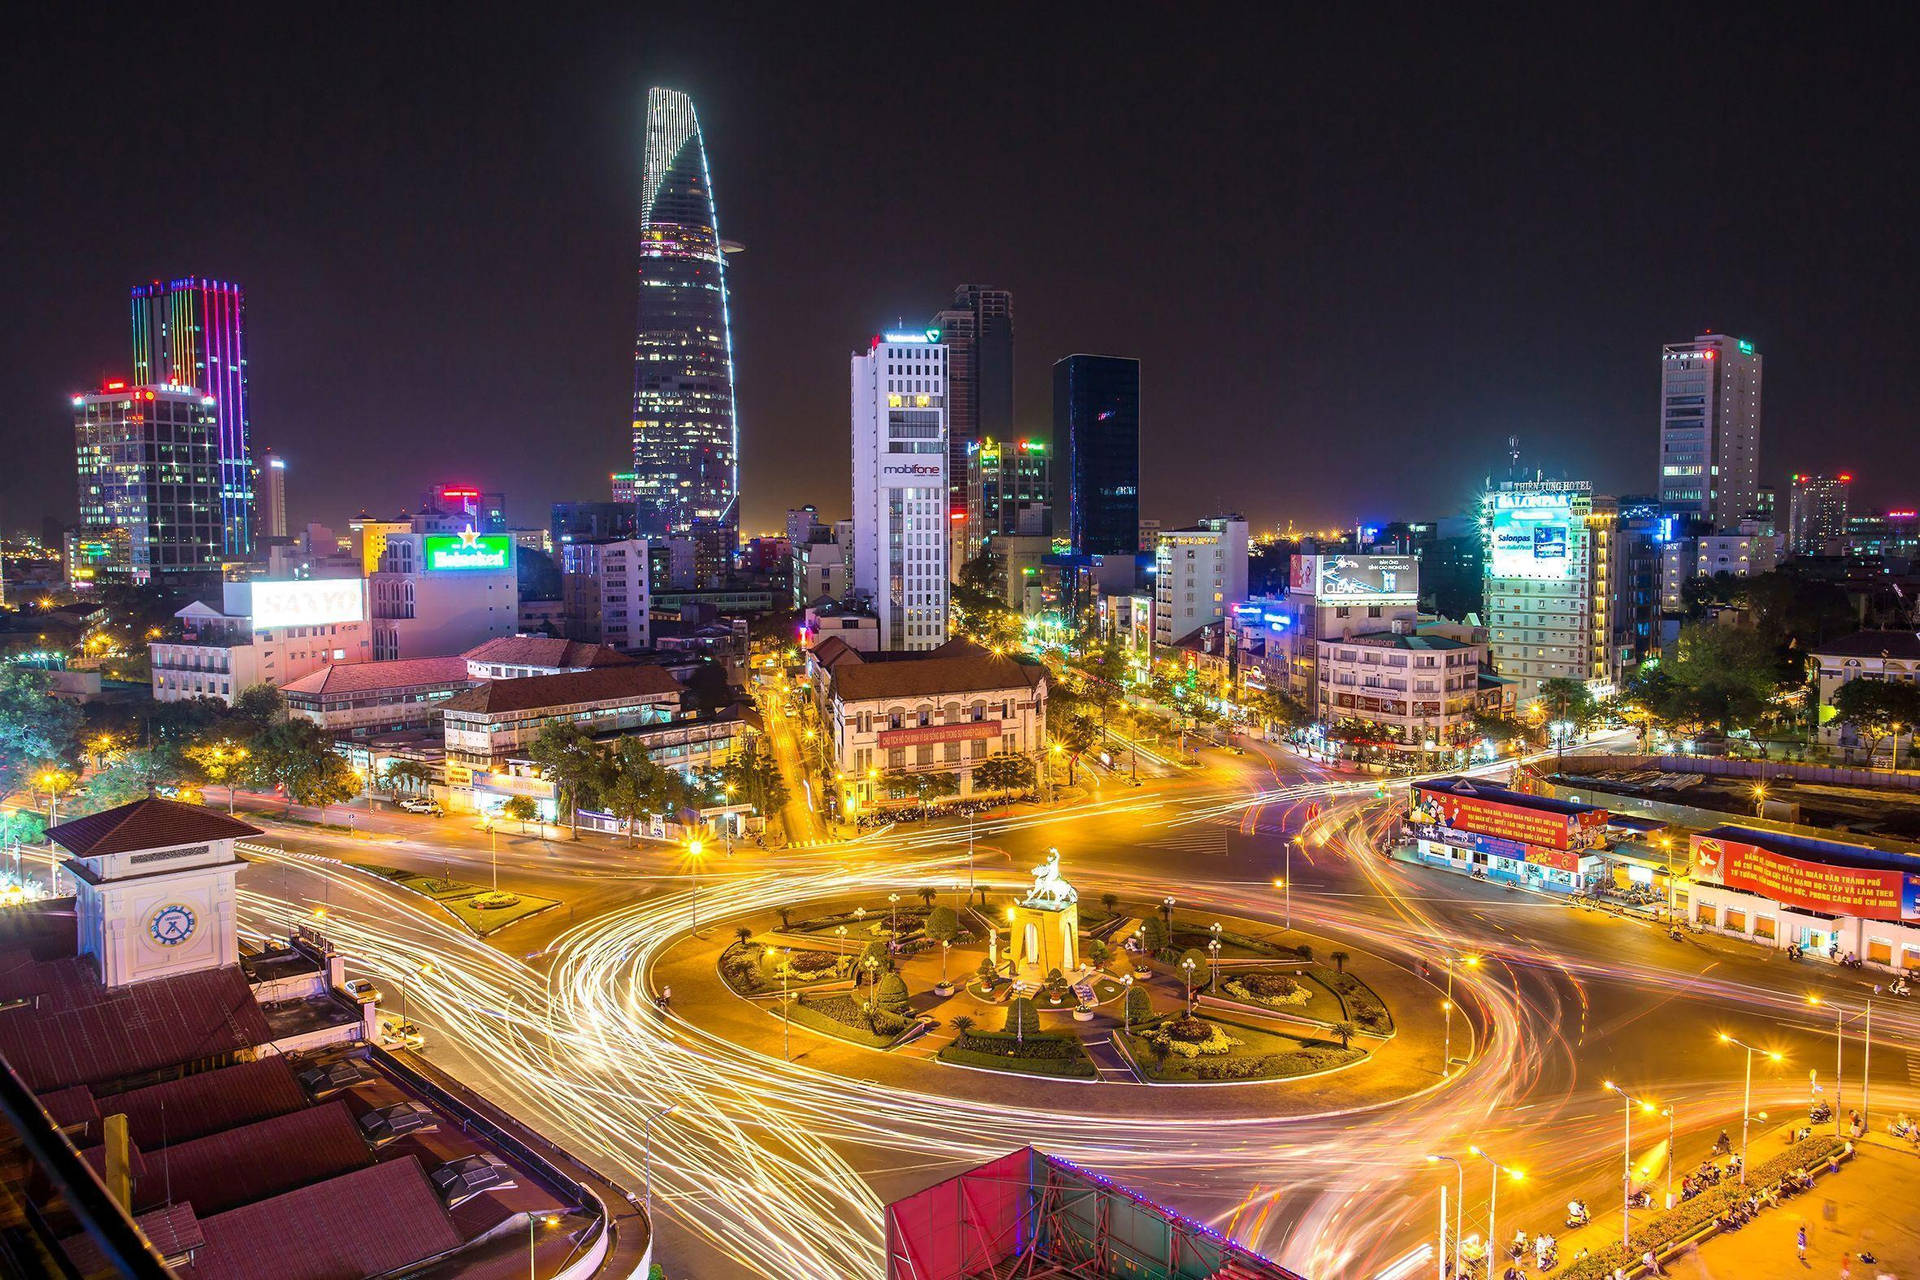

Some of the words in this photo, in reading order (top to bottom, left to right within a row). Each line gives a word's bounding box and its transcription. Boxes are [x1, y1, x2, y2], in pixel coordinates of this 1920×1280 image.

[884, 464, 940, 474] mobifone
[1514, 480, 1539, 491] THIÊN
[1541, 480, 1563, 491] TÙNG
[1564, 481, 1592, 490] HOTEL
[1498, 534, 1531, 543] Salonpas
[1876, 890, 1894, 898] THEO
